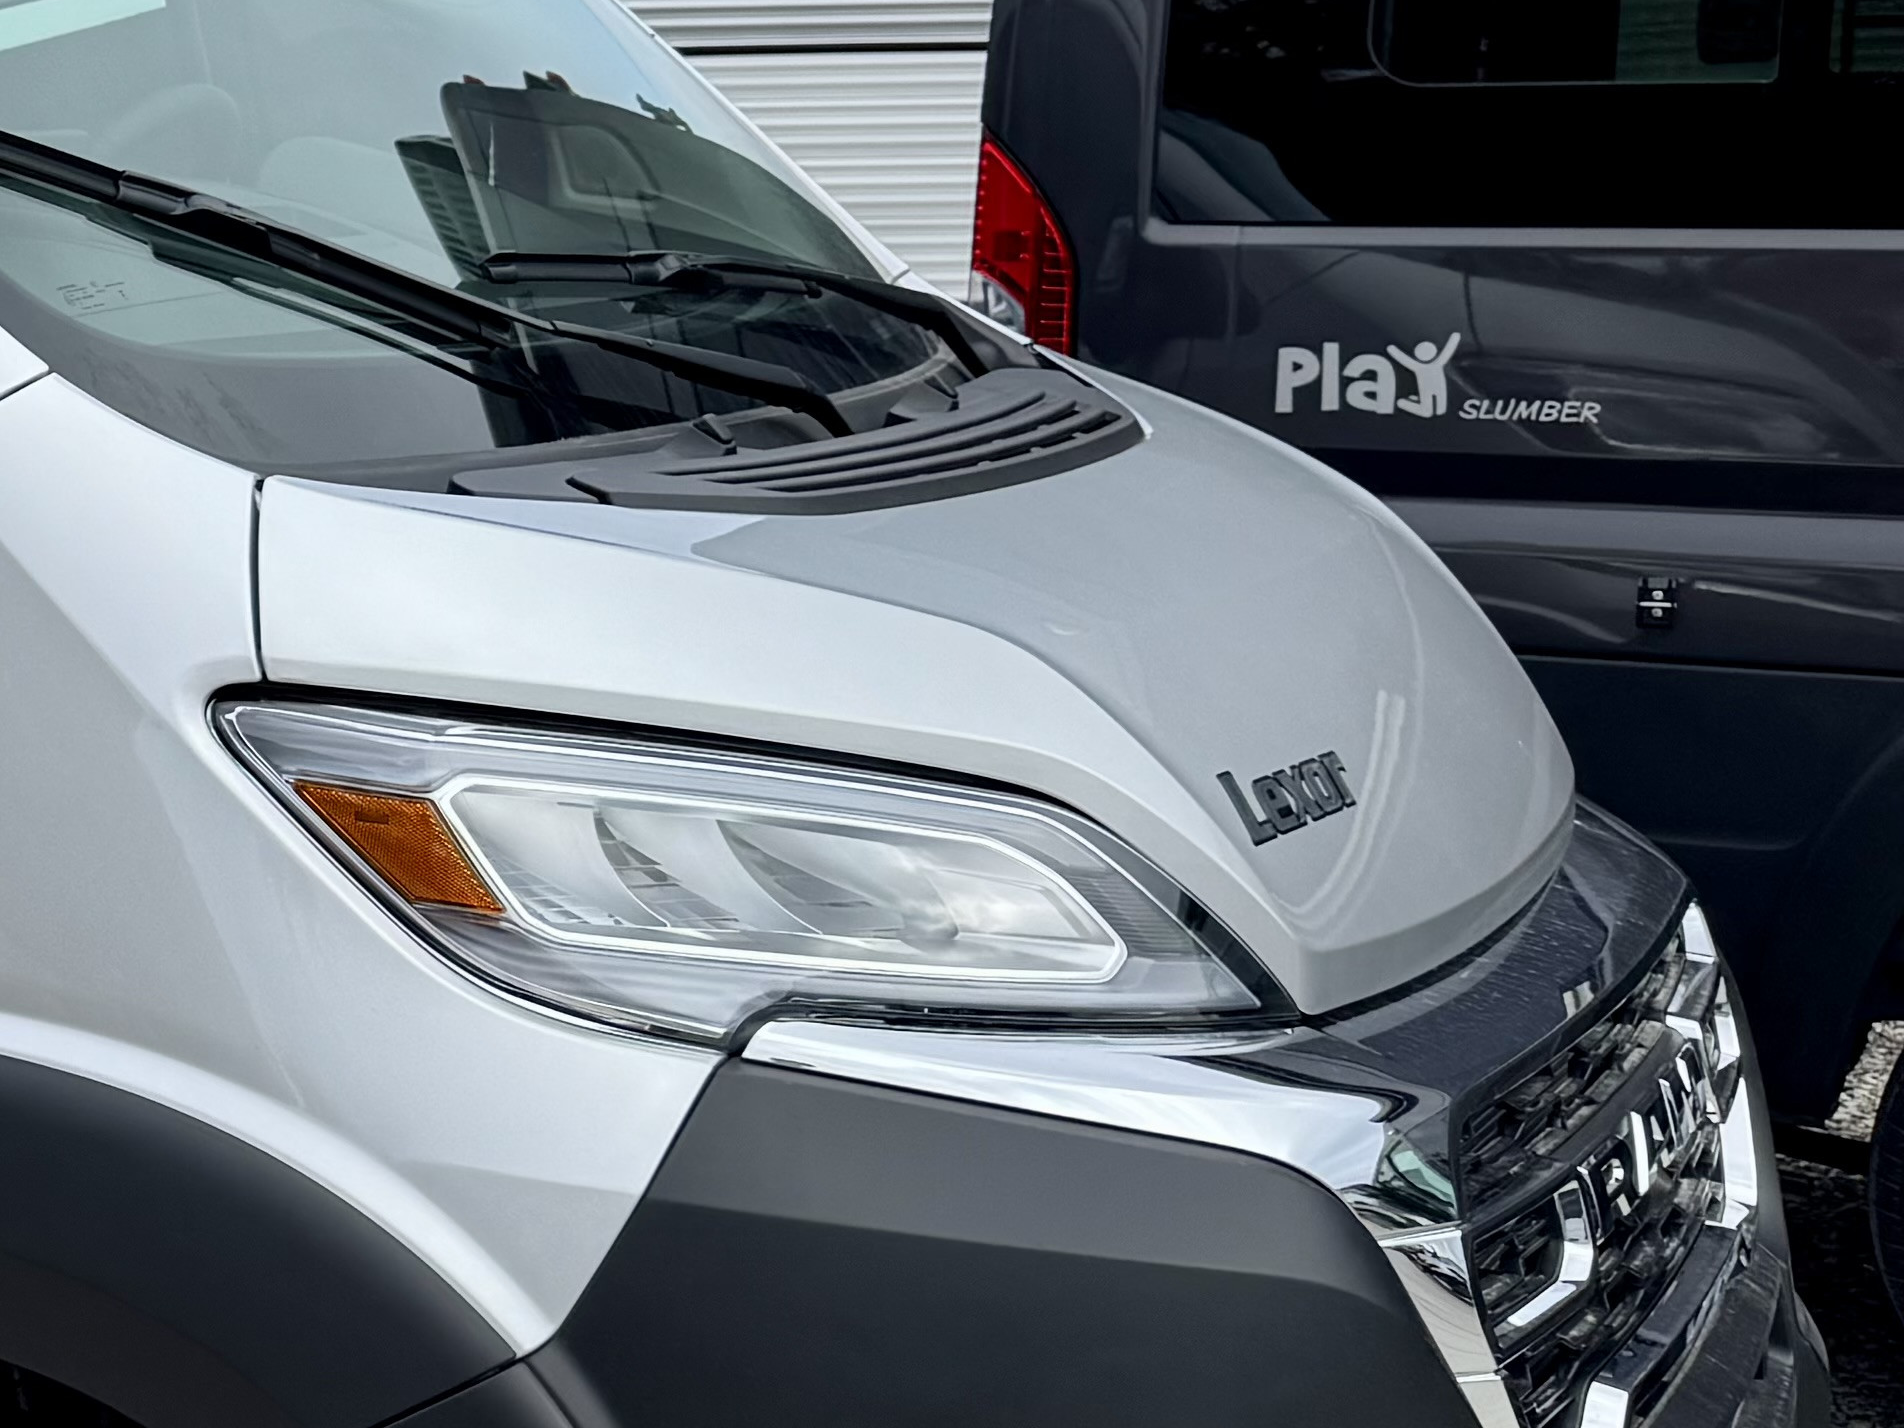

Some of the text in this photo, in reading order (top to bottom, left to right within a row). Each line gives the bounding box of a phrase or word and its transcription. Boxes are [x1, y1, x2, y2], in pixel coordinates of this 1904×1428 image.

[1274, 332, 1601, 425] Play SLUMBER
[1216, 749, 1358, 847] Lexor
